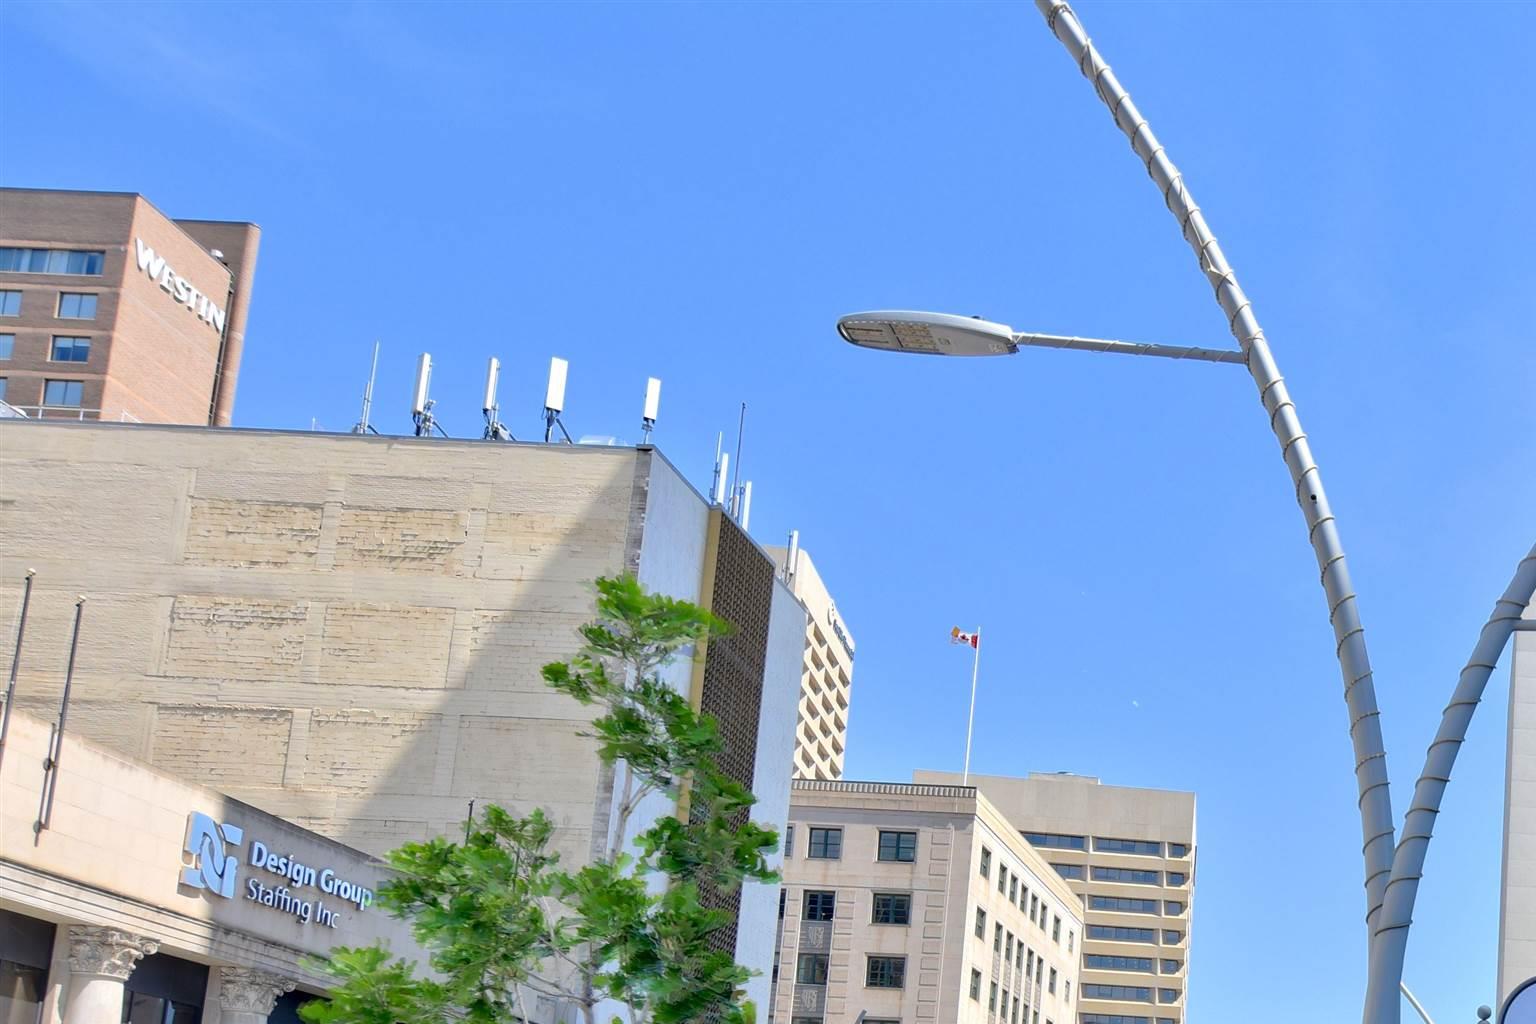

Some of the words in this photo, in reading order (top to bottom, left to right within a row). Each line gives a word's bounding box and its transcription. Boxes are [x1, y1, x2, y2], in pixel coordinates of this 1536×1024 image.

[136, 238, 225, 331] WESTIN
[247, 878, 311, 924] Staffing
[316, 901, 341, 929] Inc
[252, 841, 316, 889] Design
[320, 868, 373, 910] Group
